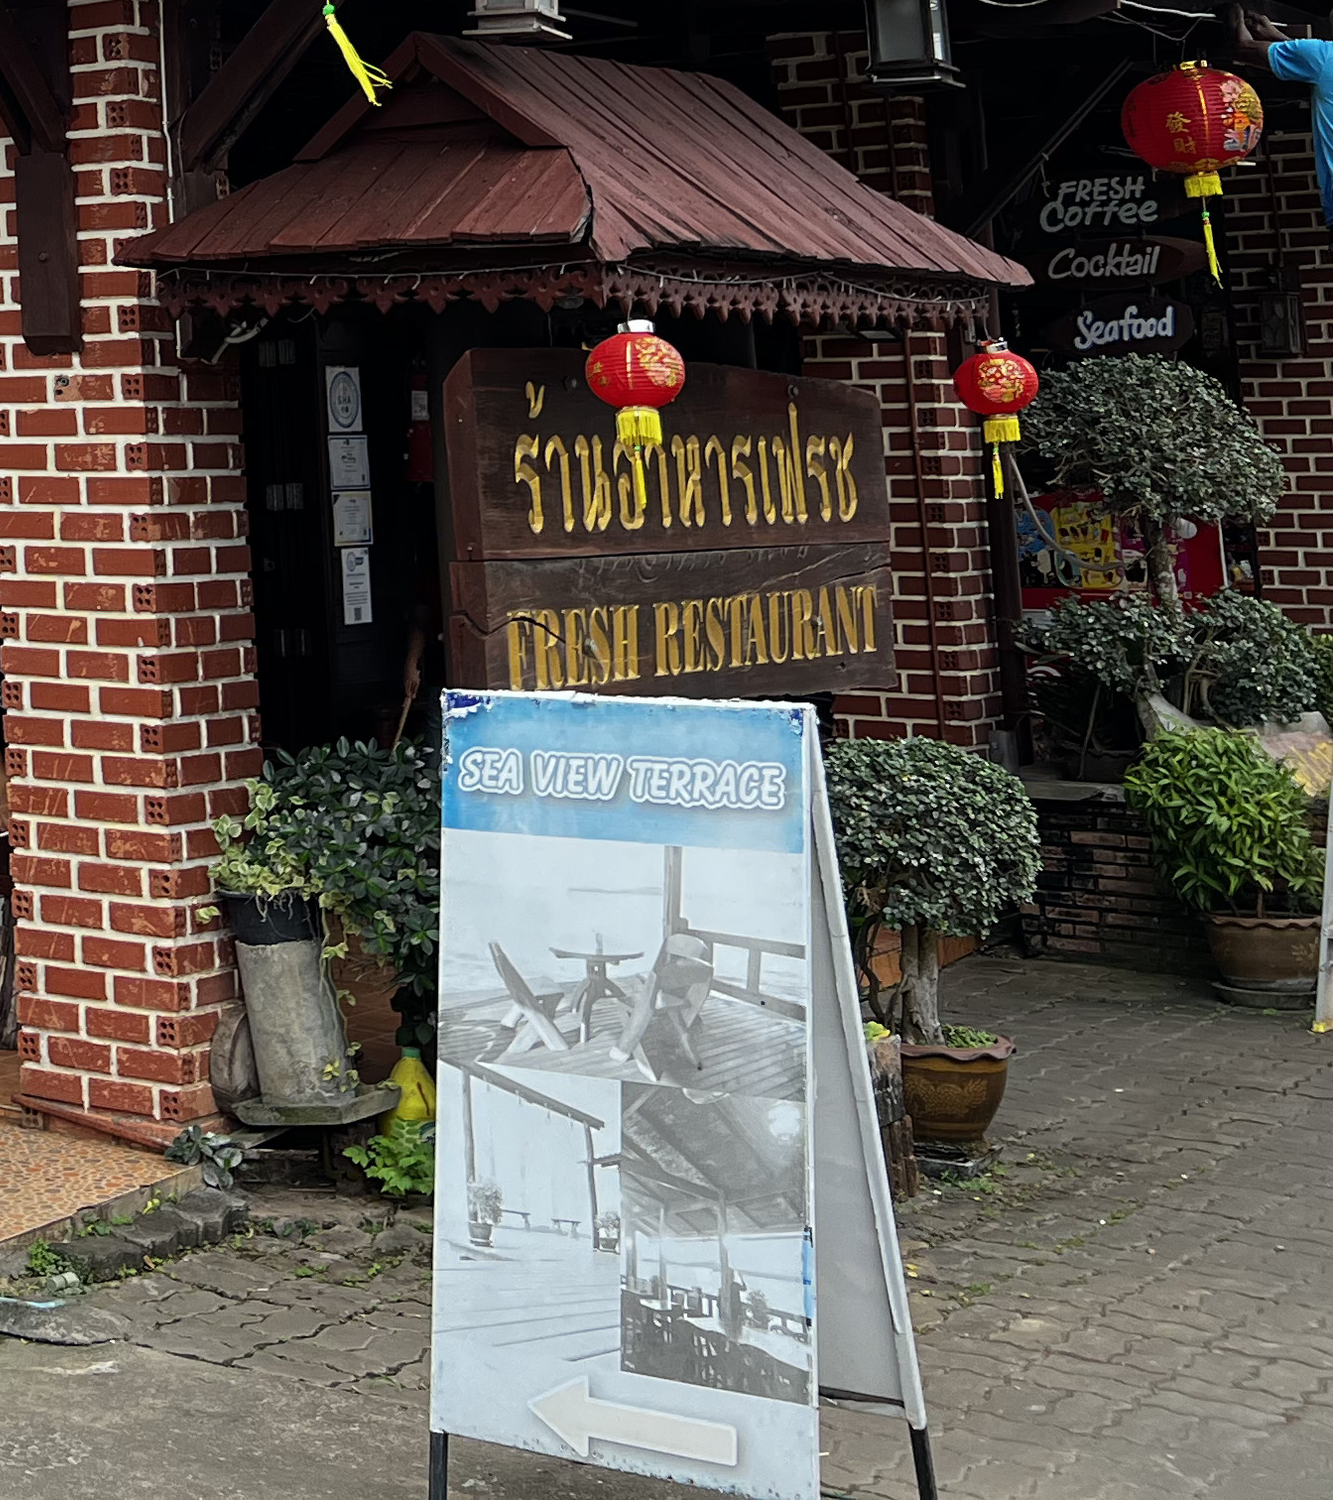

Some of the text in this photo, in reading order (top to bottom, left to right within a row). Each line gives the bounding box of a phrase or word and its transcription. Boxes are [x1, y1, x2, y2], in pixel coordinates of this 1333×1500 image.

[1057, 176, 1145, 203] FRESH
[1040, 200, 1158, 233] Coffee
[1048, 243, 1161, 279] Cocktail
[1074, 305, 1174, 350] Seafood
[514, 380, 859, 534] ร้านอาหารเฟรช
[506, 584, 878, 692] FRESH RESTAURANT
[459, 748, 786, 810] SEA VIEW TERRACE
